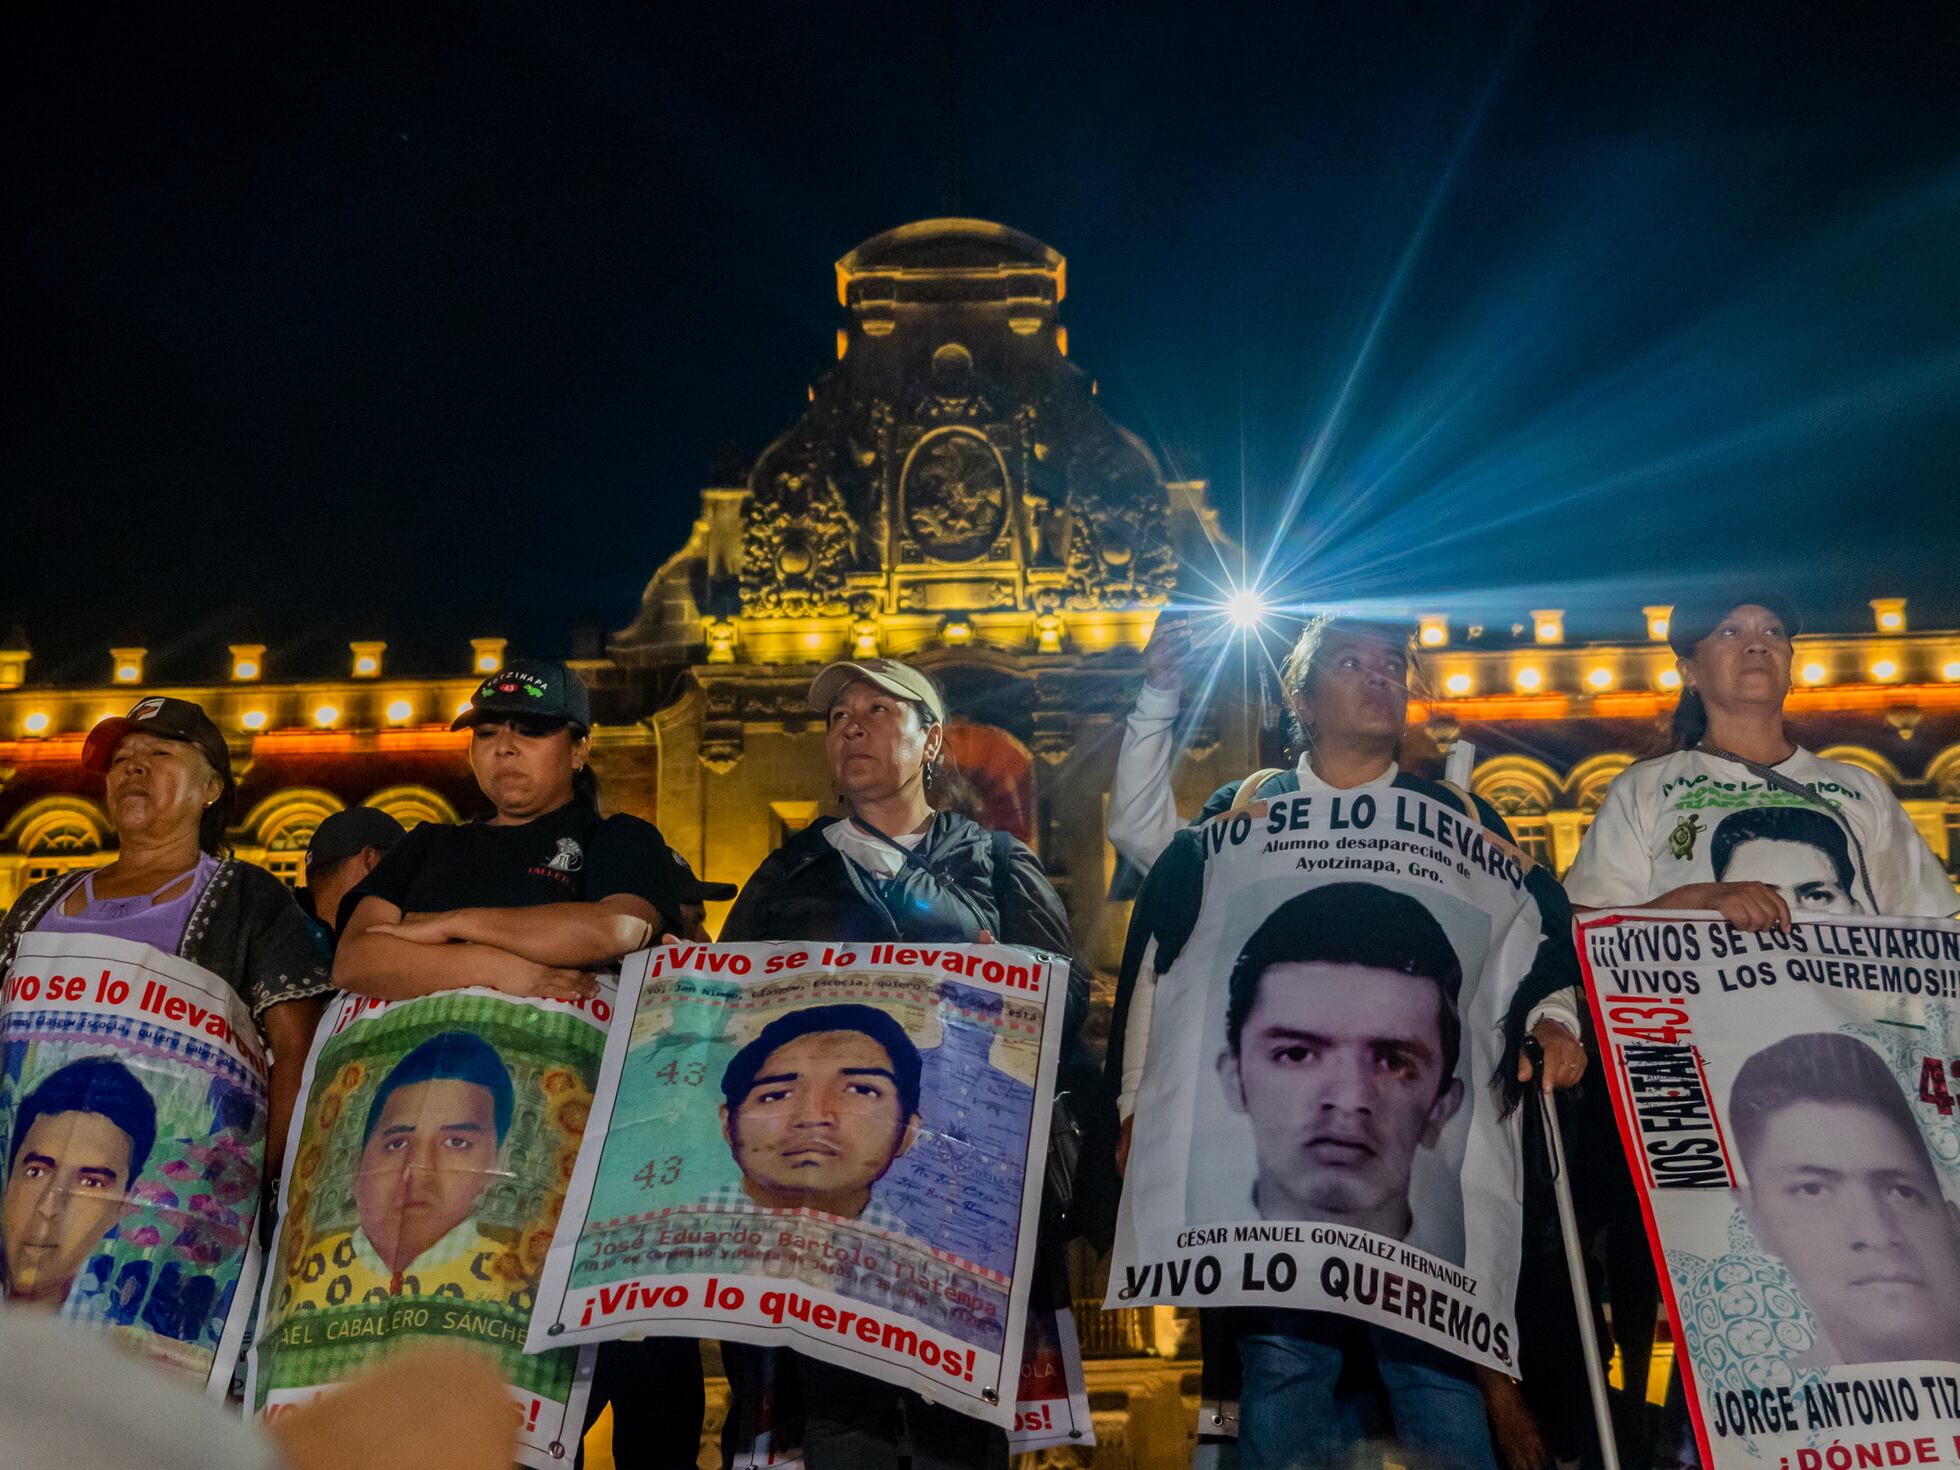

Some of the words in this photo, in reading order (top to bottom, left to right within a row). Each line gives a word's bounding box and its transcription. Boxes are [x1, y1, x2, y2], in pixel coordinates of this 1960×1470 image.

[1267, 798, 1311, 834] SE
[1330, 794, 1376, 829] LO
[1262, 837, 1329, 855] Alumno
[1336, 835, 1452, 867] desaparecido
[1456, 862, 1471, 880] de
[1296, 855, 1401, 875] Ayotzinapa,
[1408, 862, 1444, 884] Gro.
[1708, 922, 1748, 958] SE
[1754, 923, 1808, 954] LOS
[1813, 924, 1960, 962] LLEVARON
[46, 975, 87, 1001] se
[95, 970, 130, 1005] lo
[652, 946, 752, 978] ¡Vivo
[764, 951, 809, 975] se
[821, 947, 857, 967] lo
[870, 944, 1041, 992] llevaron!
[1611, 969, 1701, 995] VIVOS
[1717, 962, 1777, 992] LOS
[1605, 994, 1692, 1044] 43!
[656, 1060, 706, 1087] 43
[1623, 1045, 1714, 1132] FALTAN
[633, 1155, 682, 1191] 43
[1646, 1138, 1729, 1189] NOS
[589, 1230, 644, 1258] José
[658, 1229, 762, 1246] Eduardo
[777, 1231, 878, 1270] Bartolo
[892, 1260, 997, 1319] Tlatempa
[1177, 1227, 1228, 1249] CÉSAR
[1234, 1226, 1305, 1243] MANUEL
[1311, 1228, 1396, 1263] GONZÁLEZ
[1401, 1250, 1479, 1296] HERNANDEZ
[327, 1308, 429, 1340] CABALLERO
[580, 1281, 689, 1327] ¡Vivo
[704, 1278, 745, 1311] lo
[759, 1290, 976, 1383] queremos!
[1126, 1257, 1222, 1299] VIVO
[1242, 1253, 1297, 1292] LO
[1320, 1257, 1513, 1363] QUEREMOS
[1715, 1386, 1798, 1437] JORGE
[1804, 1377, 1919, 1429] ANTONIO
